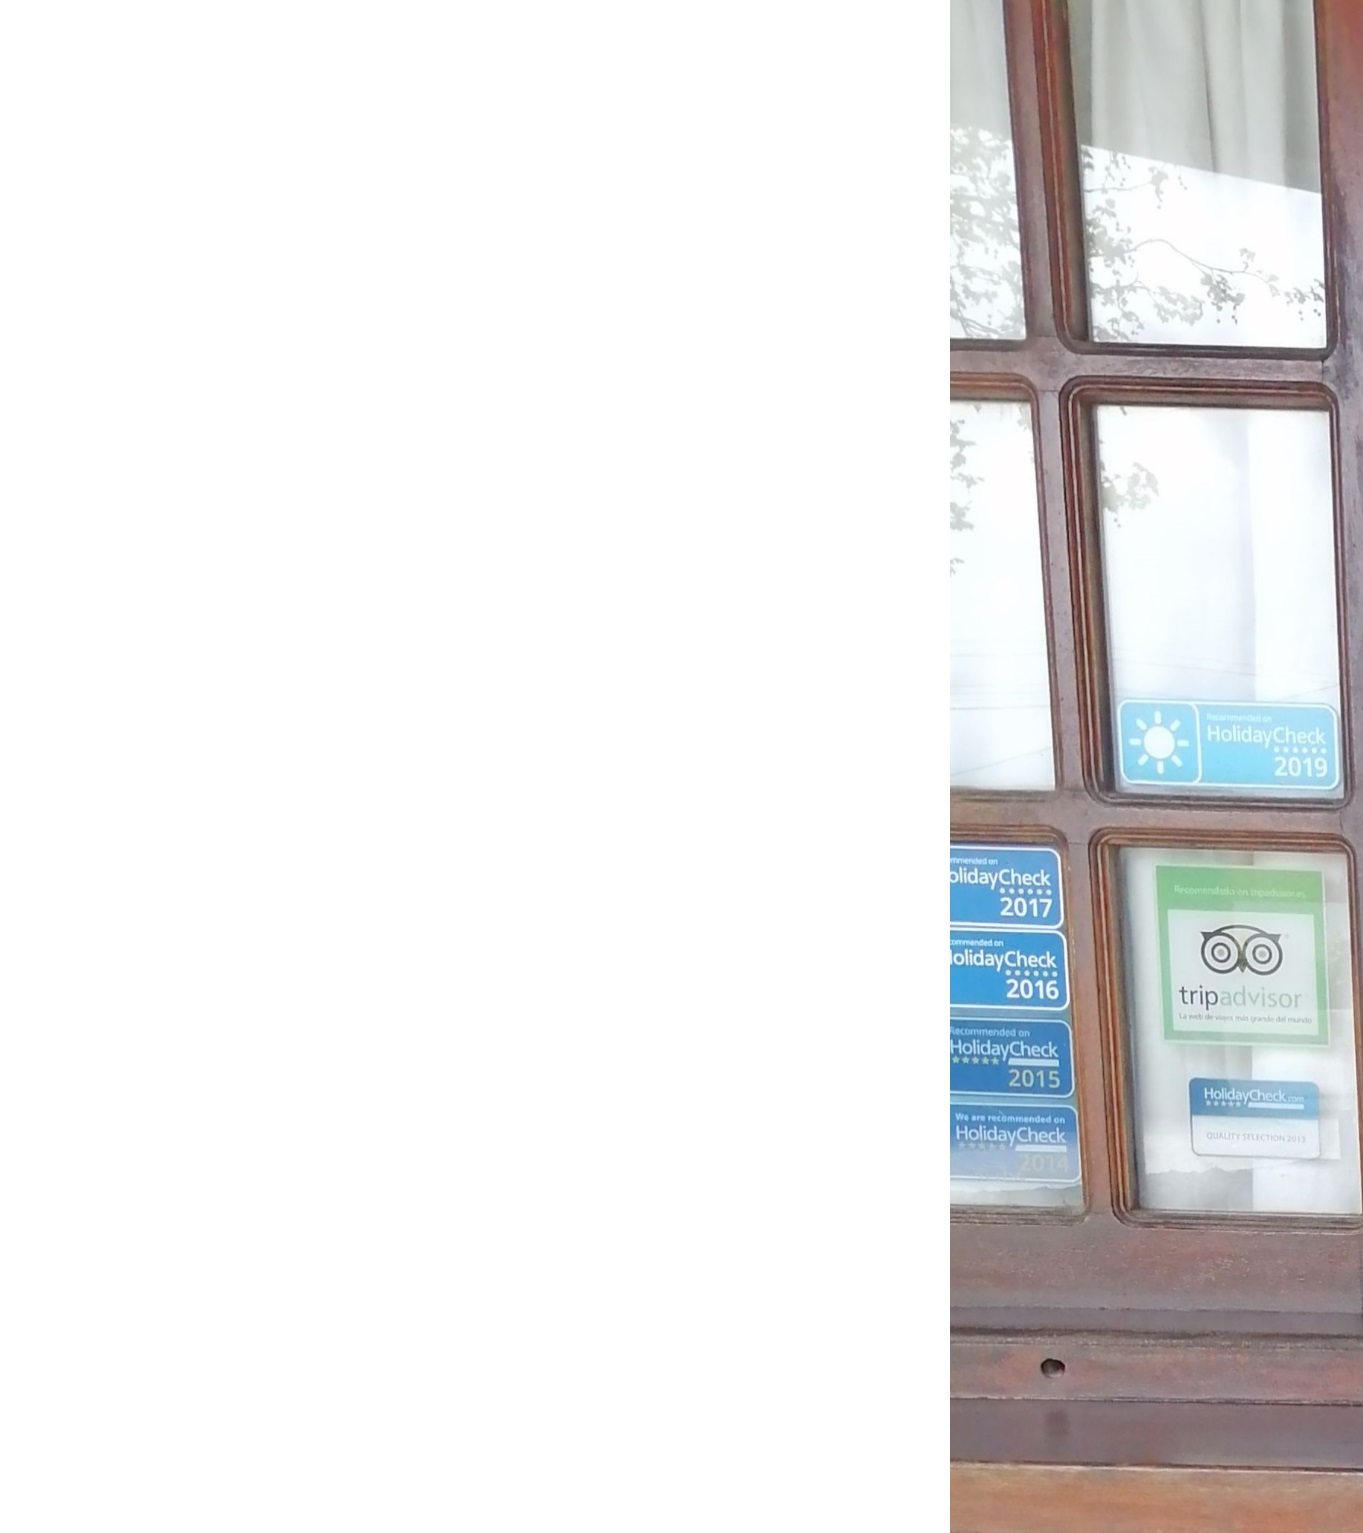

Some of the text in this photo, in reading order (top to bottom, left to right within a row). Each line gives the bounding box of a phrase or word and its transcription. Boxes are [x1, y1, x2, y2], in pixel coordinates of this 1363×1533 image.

[1206, 724, 1326, 749] HolidayCheck
[1274, 756, 1328, 778] 2019
[950, 857, 998, 866] mmended on
[1000, 897, 1053, 918] 2017
[950, 948, 1057, 972] olidayCheck
[1006, 978, 1059, 1000] 2016
[1178, 985, 1302, 1011] tripadvisor
[1188, 1013, 1203, 1021] web
[1204, 1013, 1214, 1021] de
[1235, 1013, 1249, 1022] más
[1250, 1015, 1275, 1024] grande
[1276, 1015, 1287, 1023] del
[1288, 1016, 1313, 1025] mundo
[950, 1026, 1031, 1037] Recommended on
[950, 1038, 1059, 1062] HolidayCheck
[1008, 1068, 1061, 1089] 2015
[955, 1112, 1066, 1124] We are recommended on
[955, 1125, 1067, 1148] HolidayCheck
[1206, 1131, 1240, 1141] QUALITY
[1242, 1132, 1286, 1142] SELECTION
[1020, 1152, 1069, 1173] 2014
